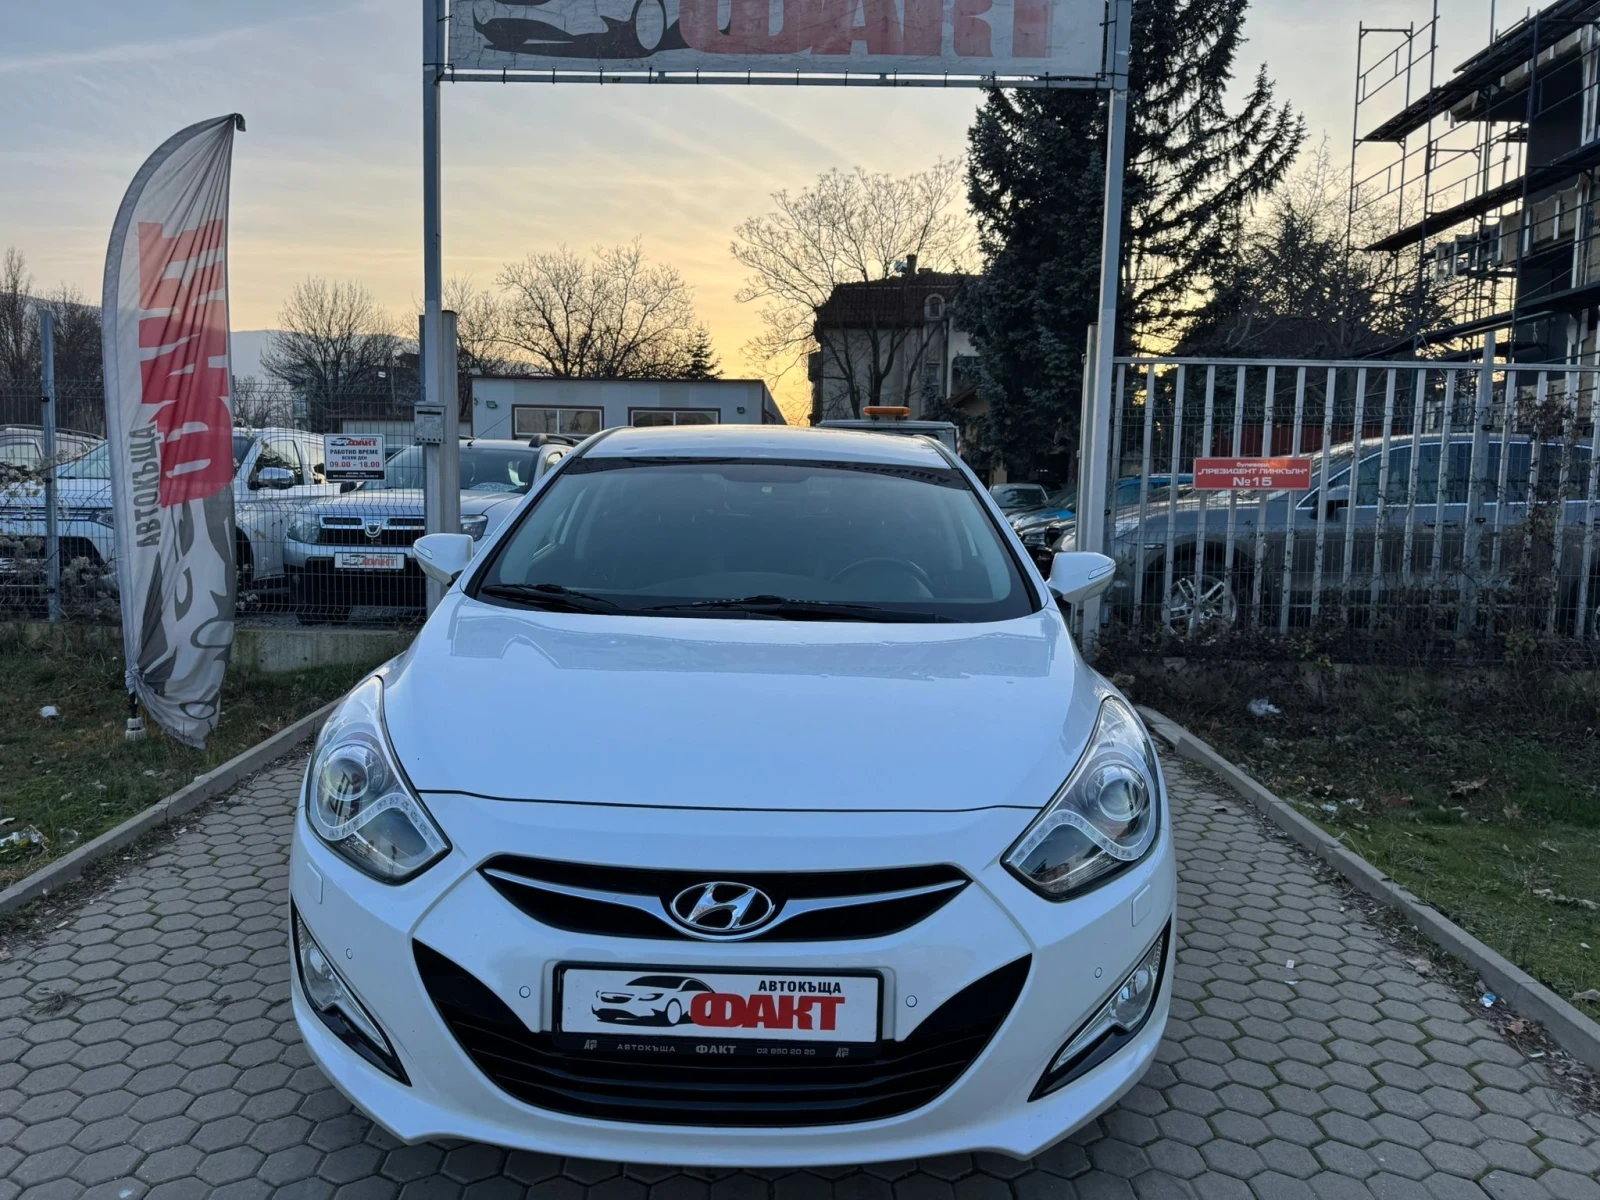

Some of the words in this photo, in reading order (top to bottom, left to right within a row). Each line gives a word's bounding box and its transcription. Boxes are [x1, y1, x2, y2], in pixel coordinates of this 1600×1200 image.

[129, 423, 161, 548] АВТОКЪЩА
[758, 980, 842, 995] АВТОКЪЩА
[690, 992, 846, 1031] ФАКТ
[695, 1044, 737, 1054] ФАКТ
